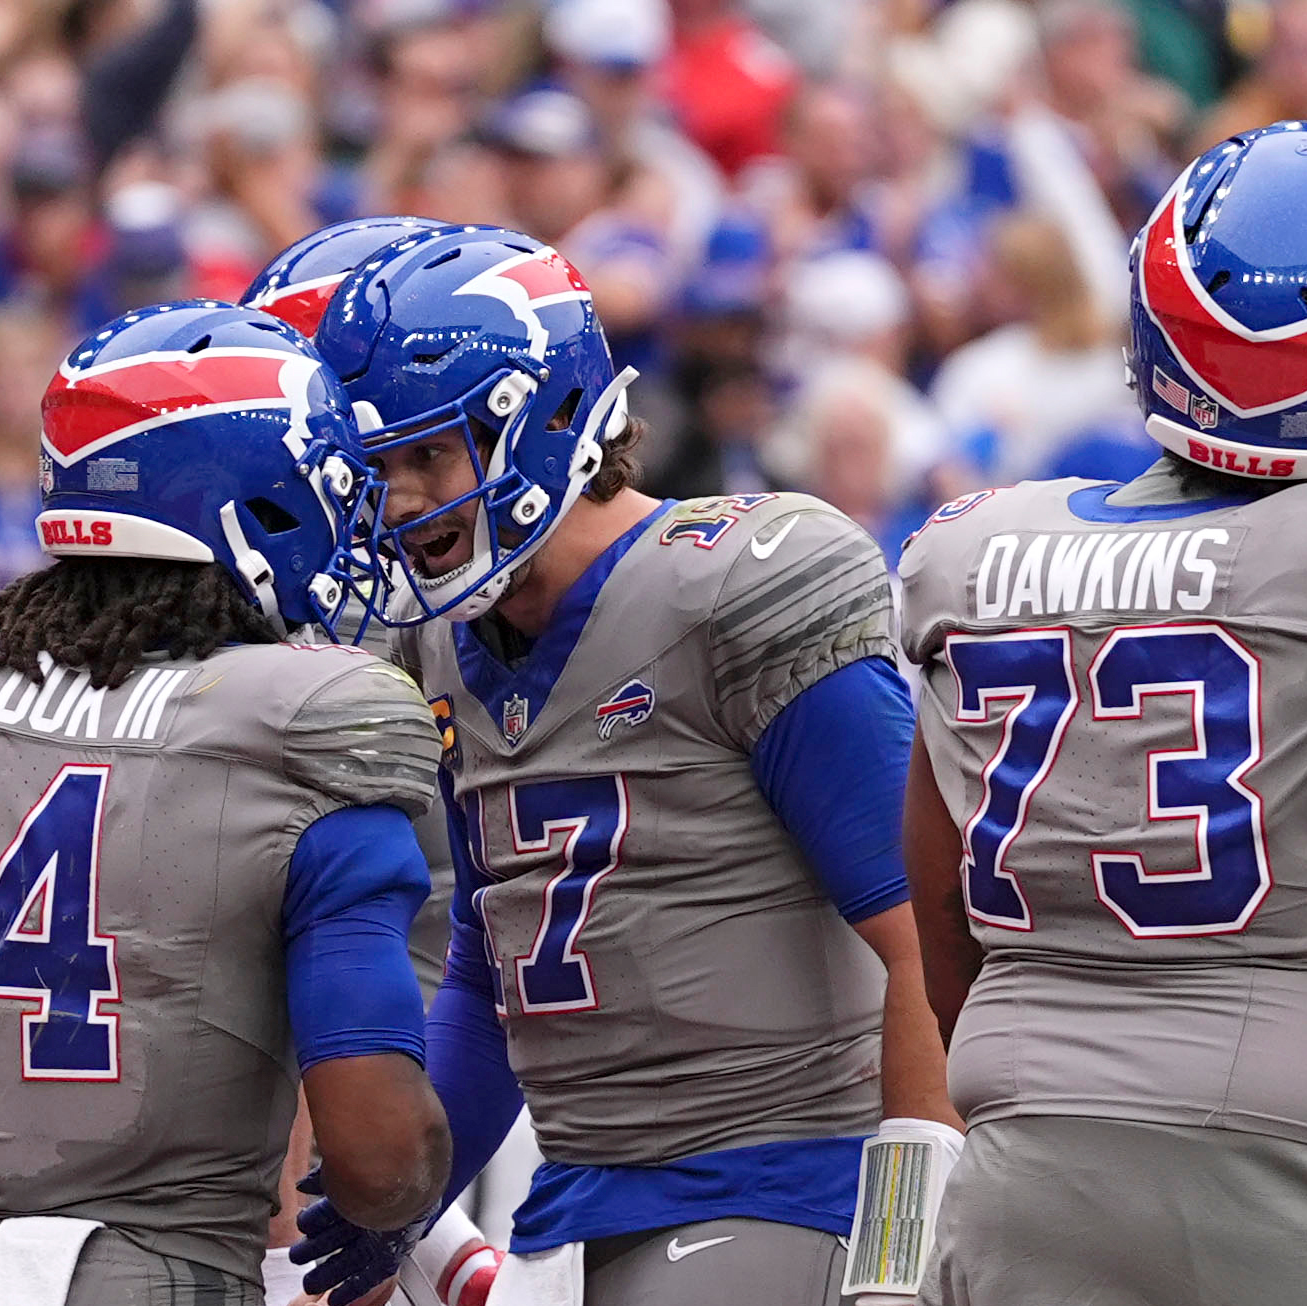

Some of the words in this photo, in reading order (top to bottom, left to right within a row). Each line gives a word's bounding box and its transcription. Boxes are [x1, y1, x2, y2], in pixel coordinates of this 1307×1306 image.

[1188, 439, 1297, 477] BILLS
[40, 520, 113, 546] BILLS
[976, 528, 1230, 619] DAWKINS
[111, 668, 191, 740] III
[944, 621, 1273, 940] 73
